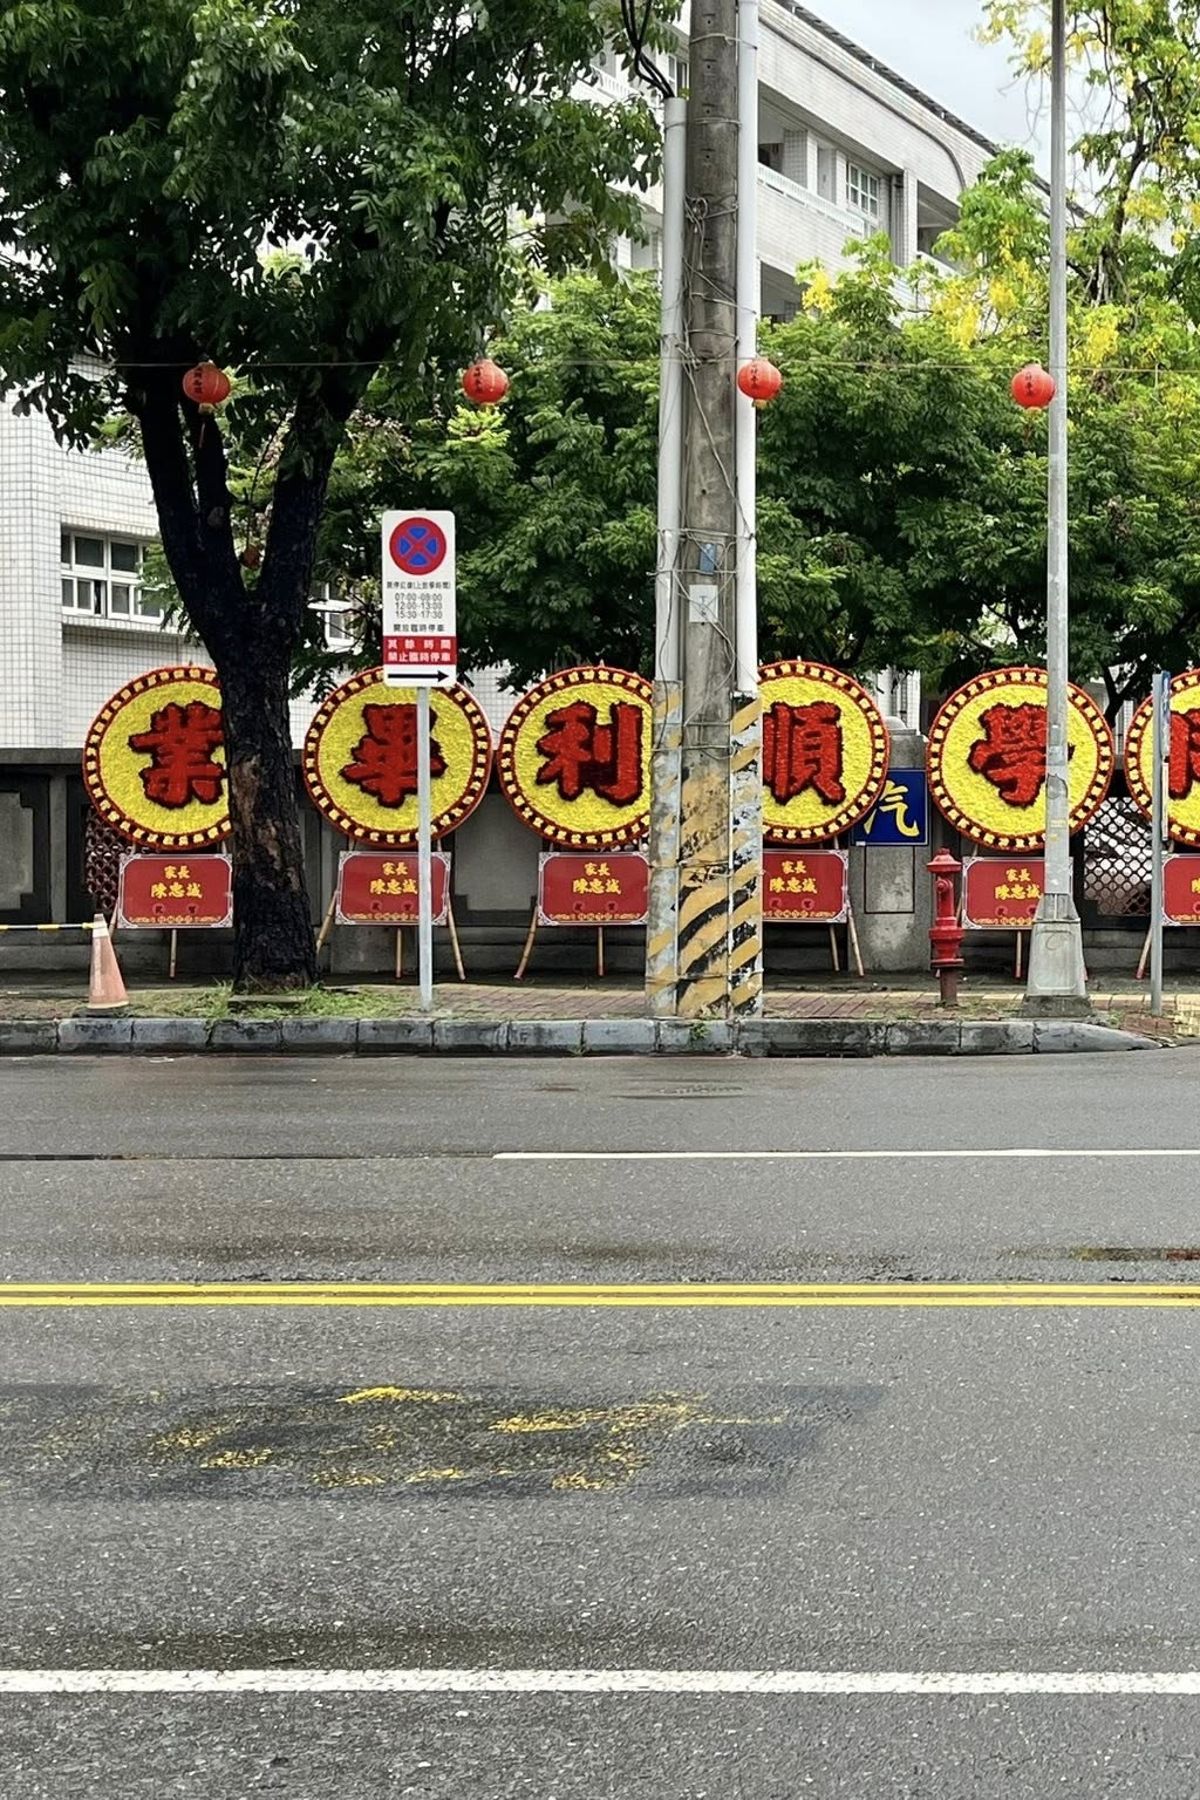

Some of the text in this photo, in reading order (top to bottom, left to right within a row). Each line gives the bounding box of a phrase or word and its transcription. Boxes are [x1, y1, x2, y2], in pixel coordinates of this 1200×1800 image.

[128, 700, 225, 808] 業
[338, 703, 448, 809] 畢
[536, 701, 643, 805] 利
[763, 701, 847, 807] 順
[967, 701, 1075, 811] 學
[164, 865, 190, 879] 家長
[382, 861, 408, 876] 家長
[584, 862, 611, 876] 家長
[782, 860, 807, 874] 家長
[1006, 868, 1031, 882] 家長
